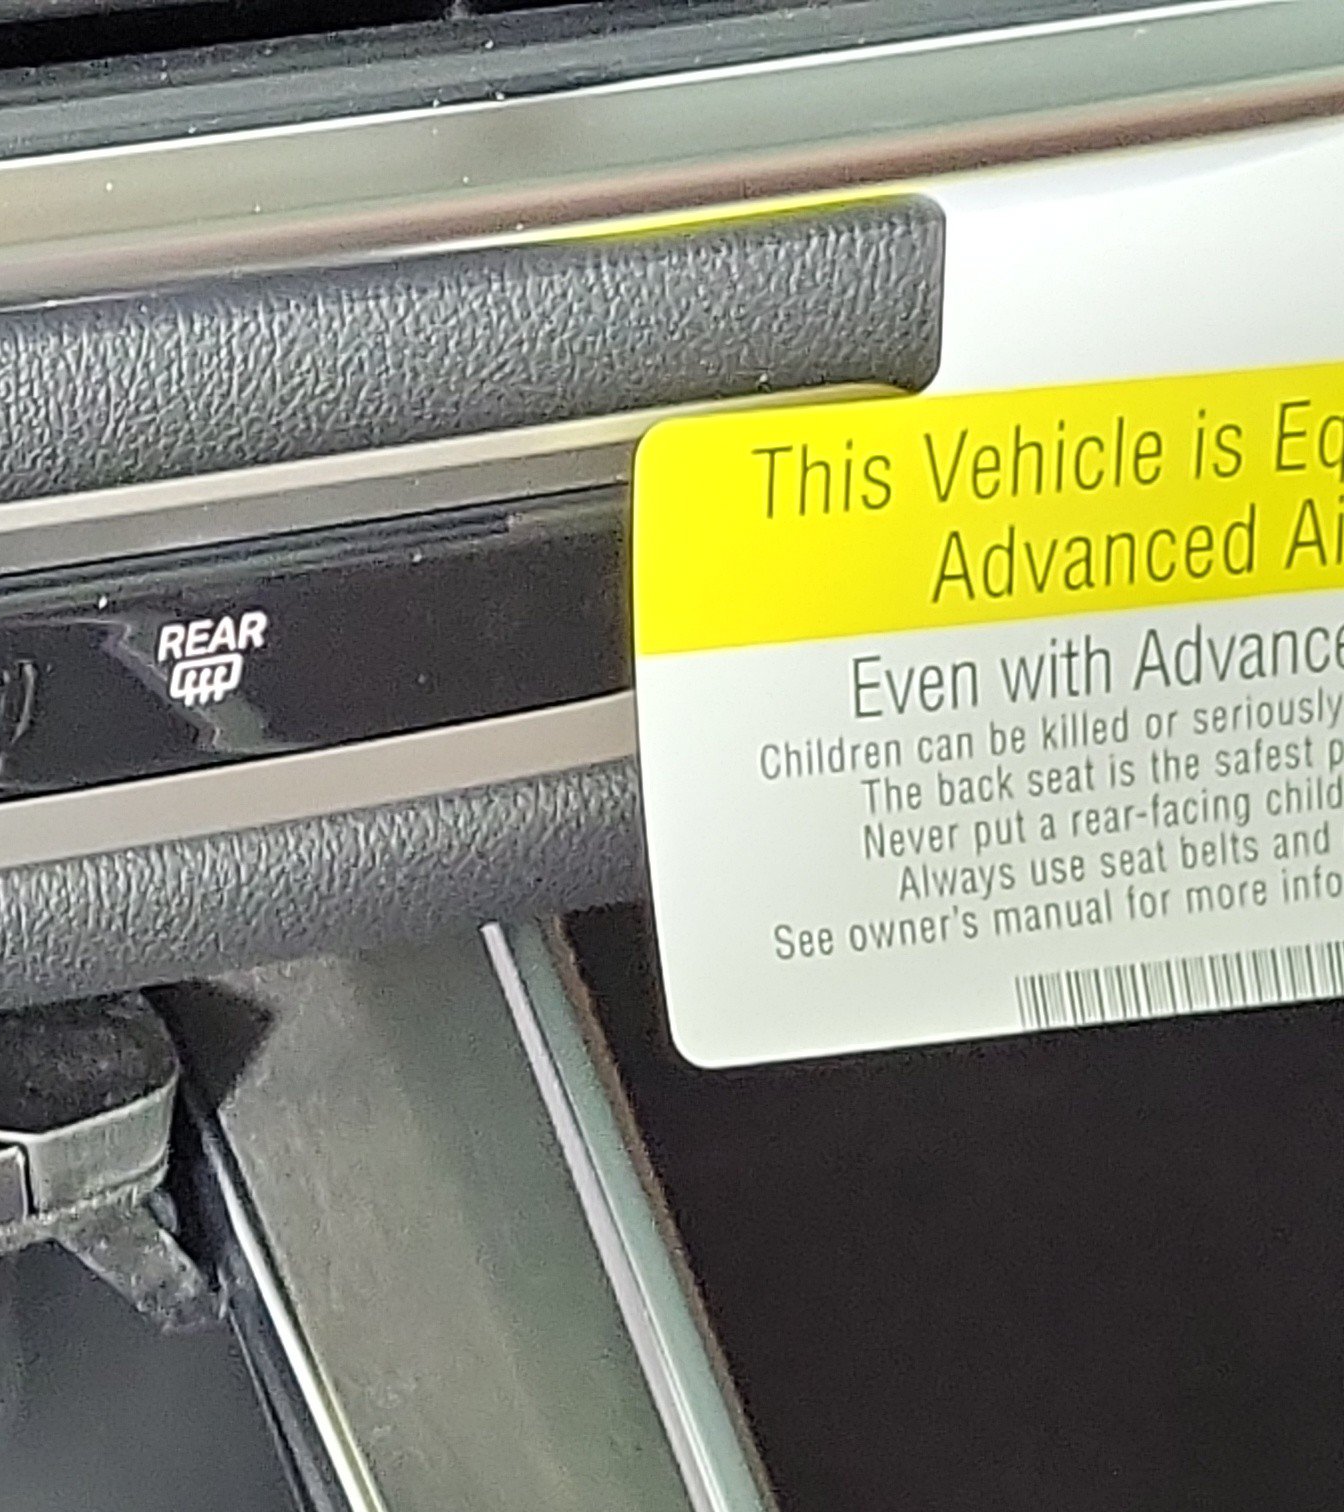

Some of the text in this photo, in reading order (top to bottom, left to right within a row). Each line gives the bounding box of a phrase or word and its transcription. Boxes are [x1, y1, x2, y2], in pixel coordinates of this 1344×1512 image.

[752, 399, 1344, 519] This Vehicle is Eq
[932, 494, 1344, 604] Advanced Ai
[158, 612, 267, 662] REAR
[853, 655, 978, 719] Even
[1000, 634, 1112, 703] with
[760, 686, 1344, 780] Children can be killed or seriously
[861, 776, 923, 817] The
[937, 763, 1015, 807] back
[1027, 756, 1096, 798] seat
[1108, 751, 1137, 789] is
[1150, 744, 1200, 785] the
[1215, 734, 1314, 778] safest
[864, 774, 1343, 860] Never put a rear-facing child
[899, 820, 1330, 903] Always use seat belts and
[774, 862, 1343, 961] See owner's manual for more info
